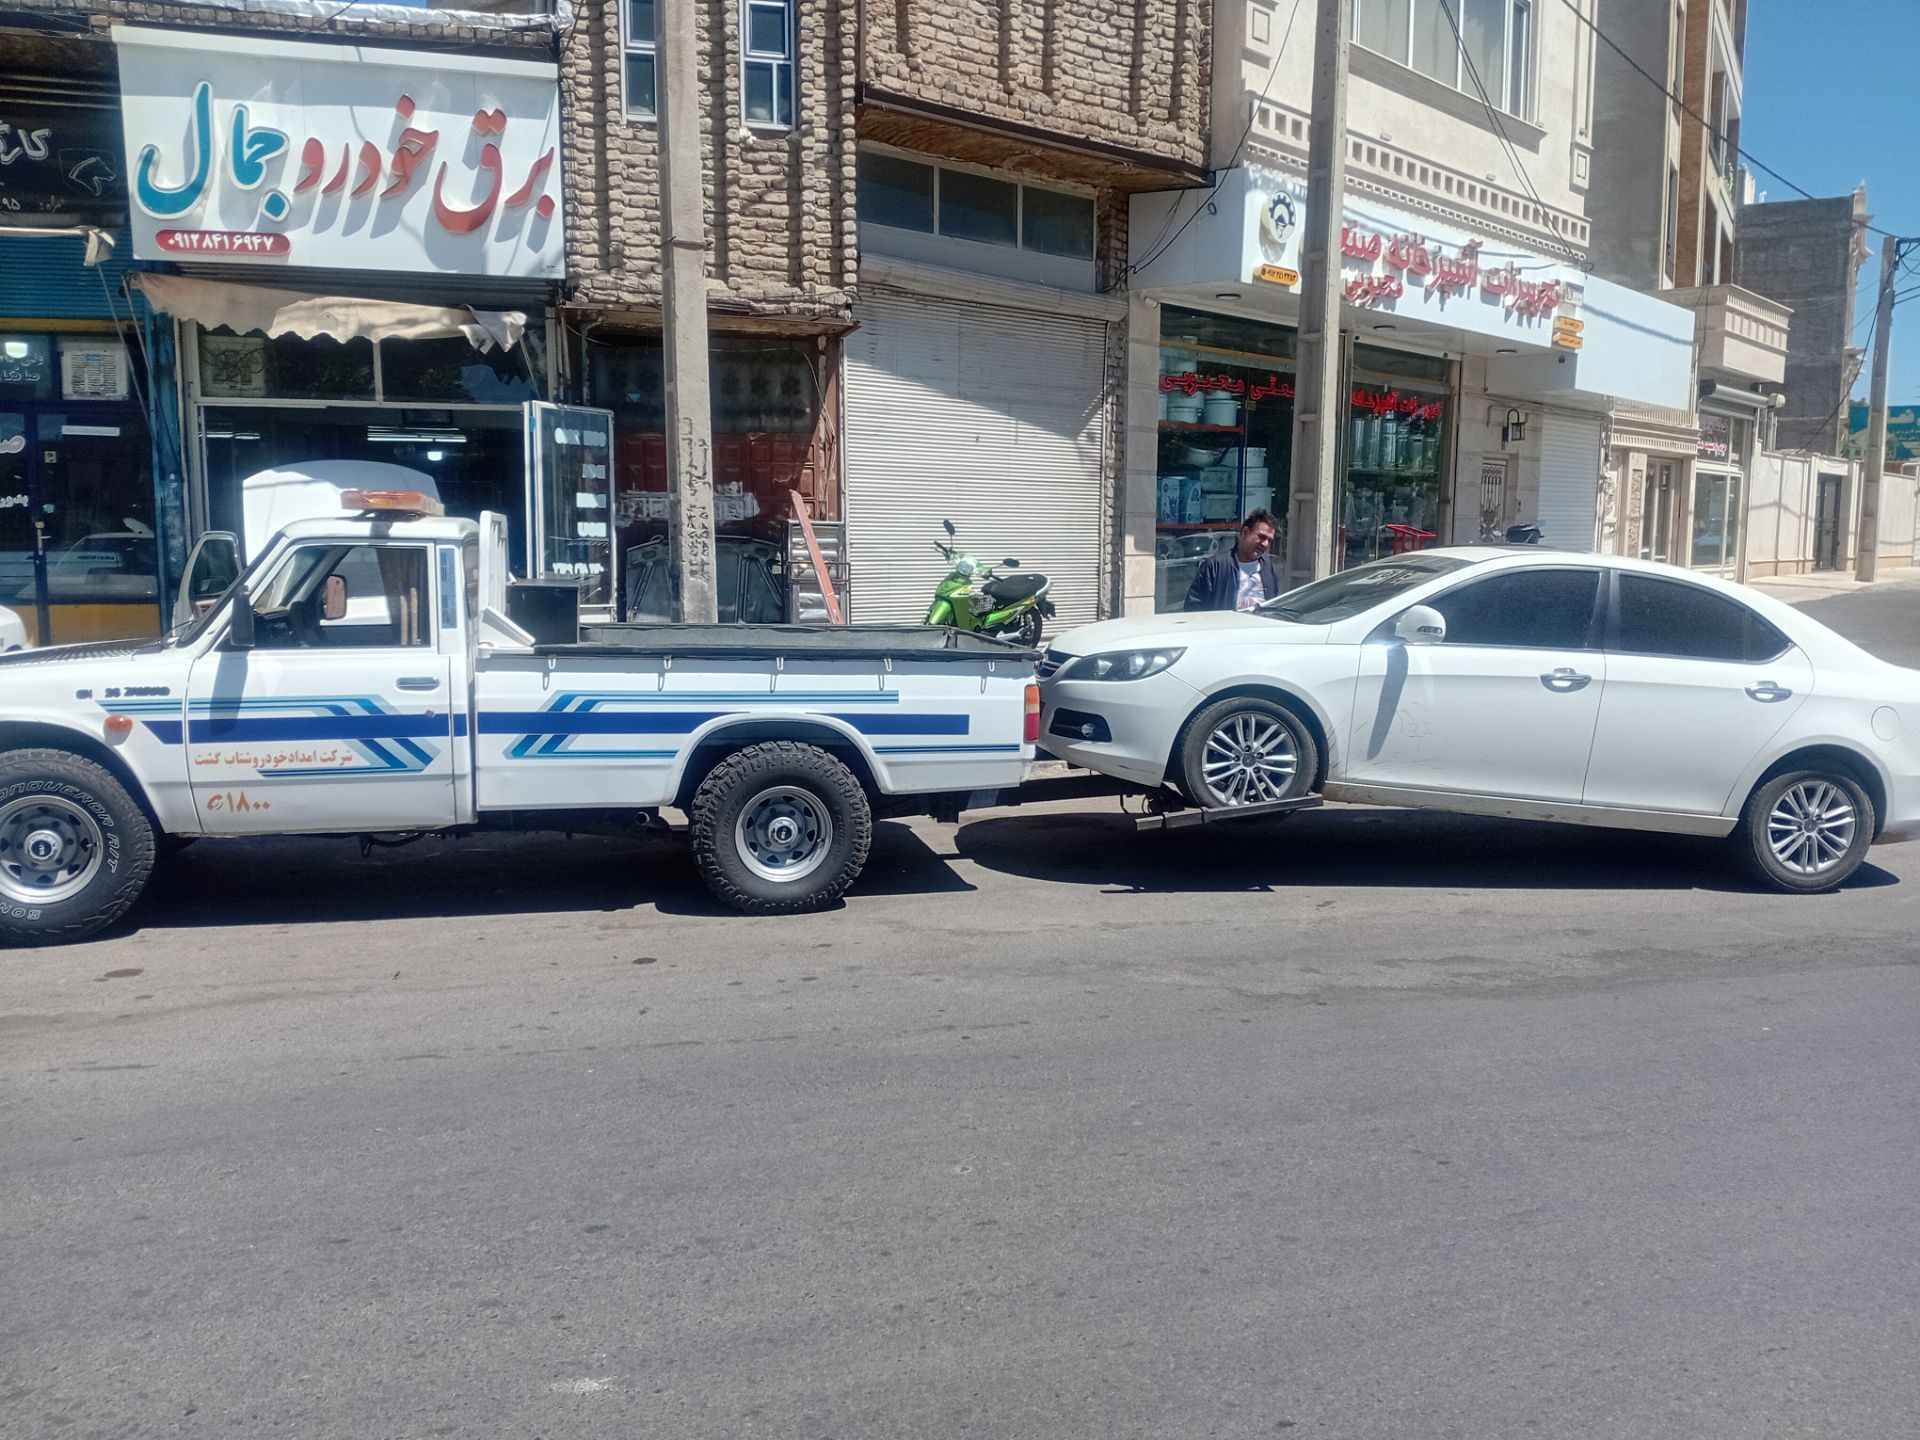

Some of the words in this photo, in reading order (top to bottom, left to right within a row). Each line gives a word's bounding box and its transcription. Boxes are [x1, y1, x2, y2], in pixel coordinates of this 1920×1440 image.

[136, 80, 291, 222] جمال
[294, 94, 440, 200] خودرو
[434, 107, 556, 235] برق
[1341, 219, 1383, 262] صنع
[1385, 232, 1484, 300] آشپزخانه
[1484, 261, 1562, 318] تجهیزات
[319, 748, 353, 766] شرکت
